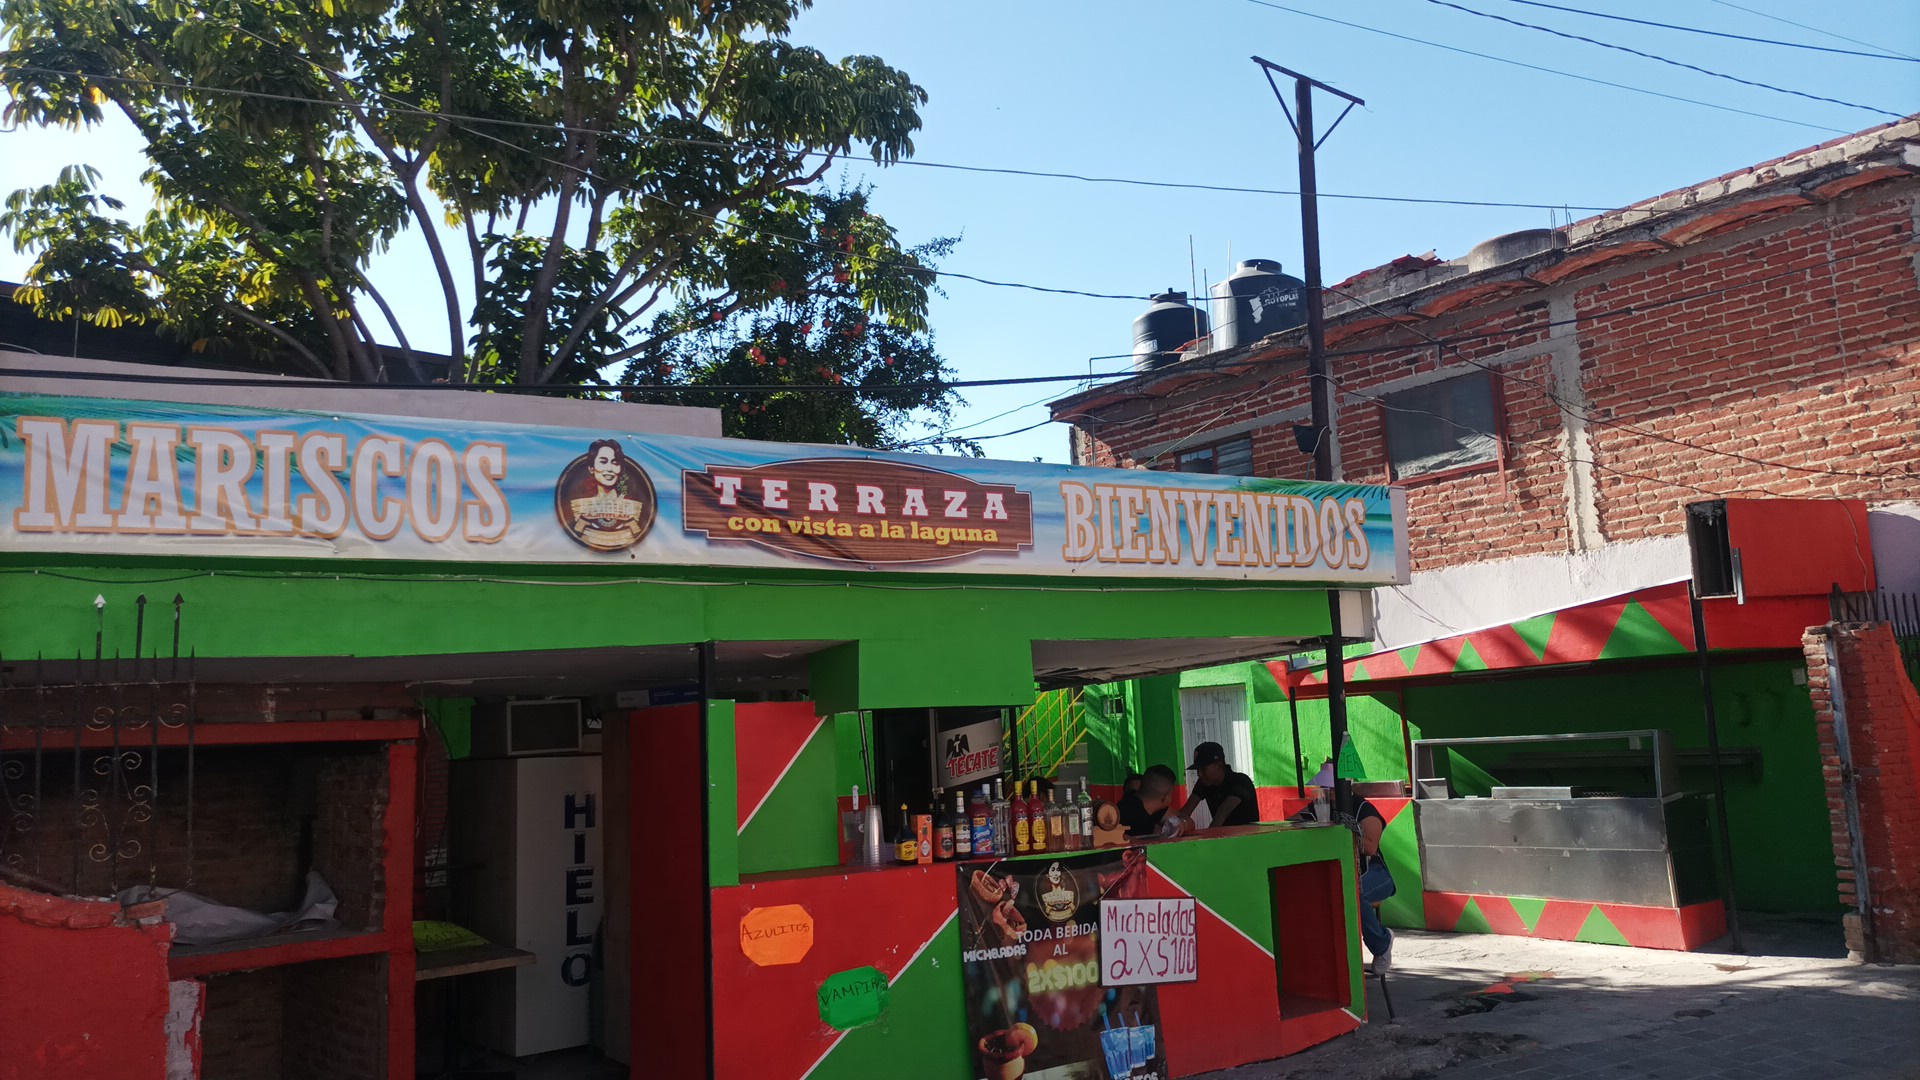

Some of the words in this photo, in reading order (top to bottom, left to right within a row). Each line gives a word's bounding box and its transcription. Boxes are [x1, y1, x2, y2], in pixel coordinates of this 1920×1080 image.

[13, 416, 511, 543] MARISCOS
[714, 475, 1008, 520] TERRAZA
[728, 517, 781, 533] con
[787, 516, 853, 537] vista
[858, 523, 876, 539] a
[880, 519, 906, 539] la
[910, 521, 999, 545] laguna
[1060, 481, 1370, 570] BIENVENIDOS
[946, 746, 999, 778] TECATE
[561, 792, 597, 988] HIELO
[741, 922, 810, 942] AZULITOS
[1016, 930, 1053, 944] TODA
[1056, 921, 1099, 939] BEBIDA
[1107, 900, 1196, 937] Micheladas
[963, 944, 1027, 963] MICHELADAS
[1053, 943, 1068, 956] AL
[1110, 938, 1133, 980] 2
